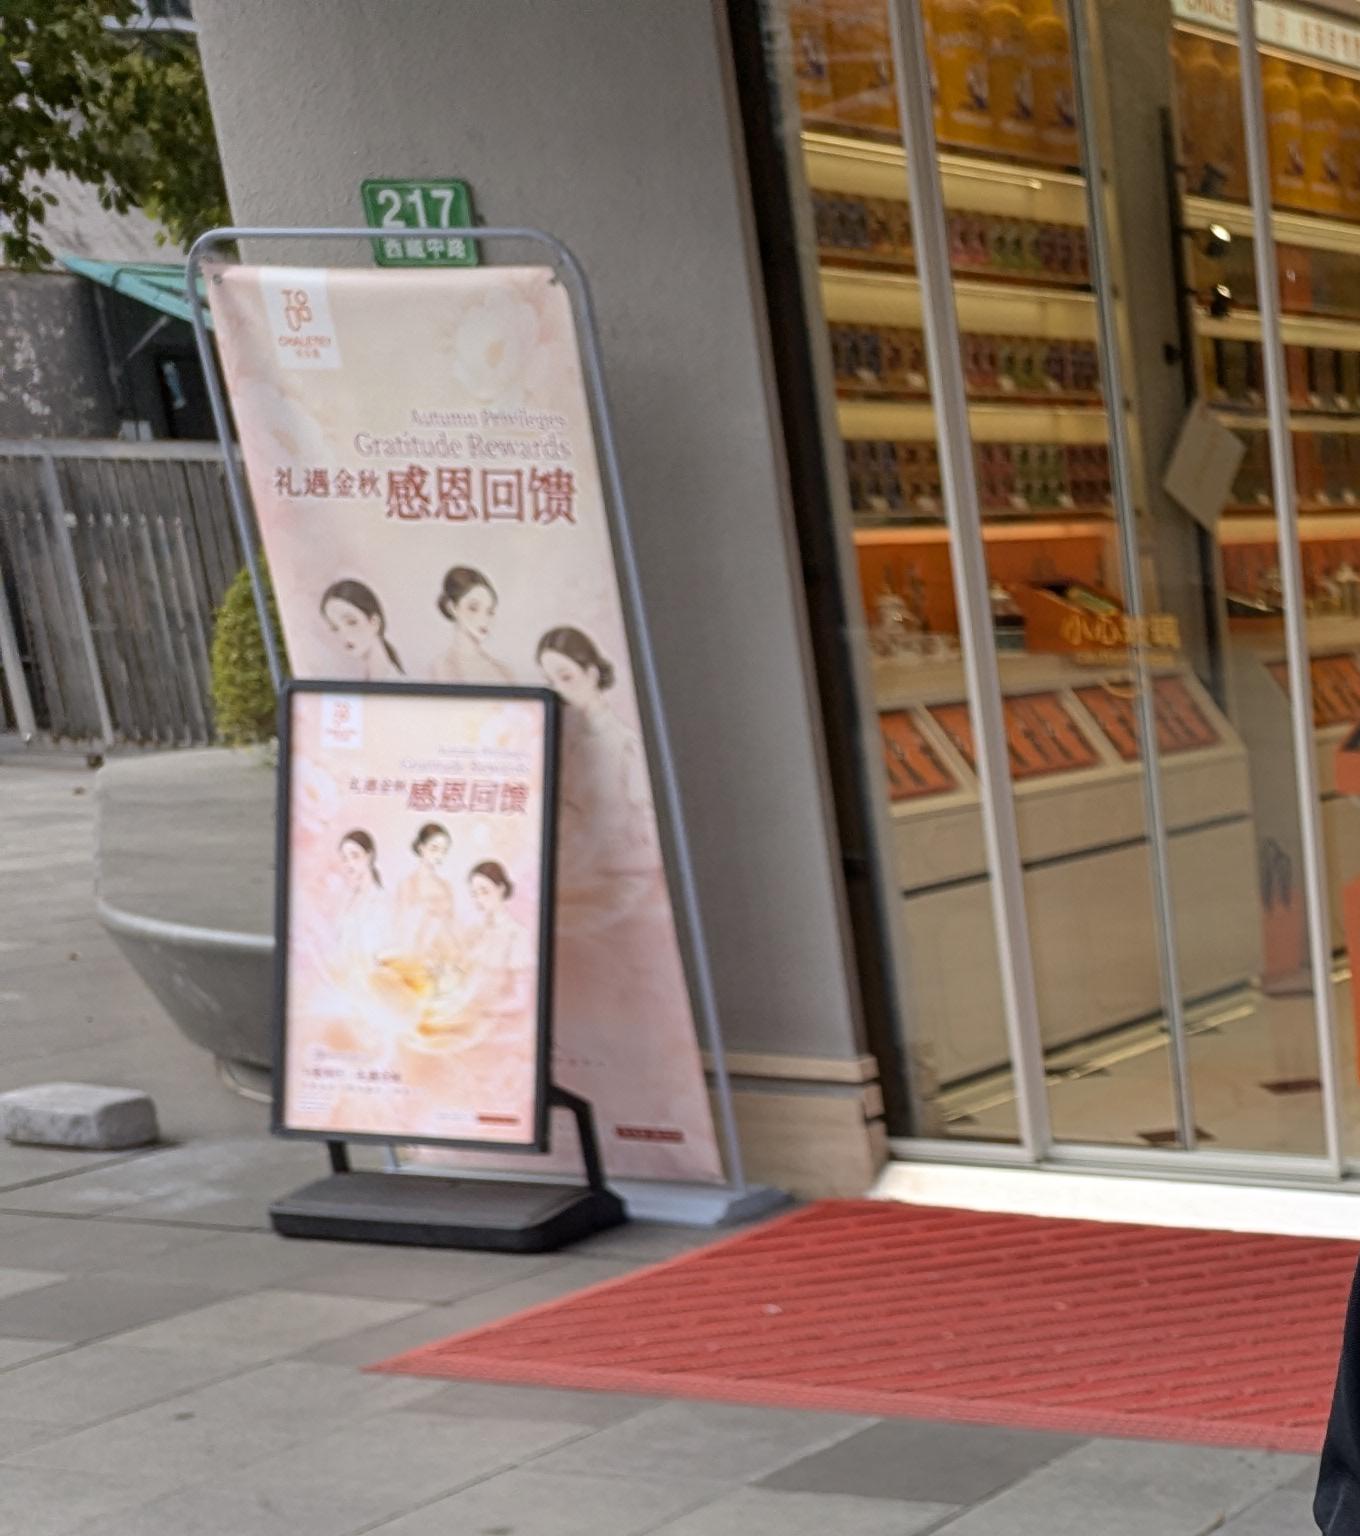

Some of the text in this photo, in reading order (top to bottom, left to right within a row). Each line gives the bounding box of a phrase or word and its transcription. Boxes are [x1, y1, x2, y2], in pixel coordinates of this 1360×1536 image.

[377, 188, 455, 228] 217
[353, 430, 573, 459] Gratitude Rewards
[385, 463, 577, 524] 感恩回馈
